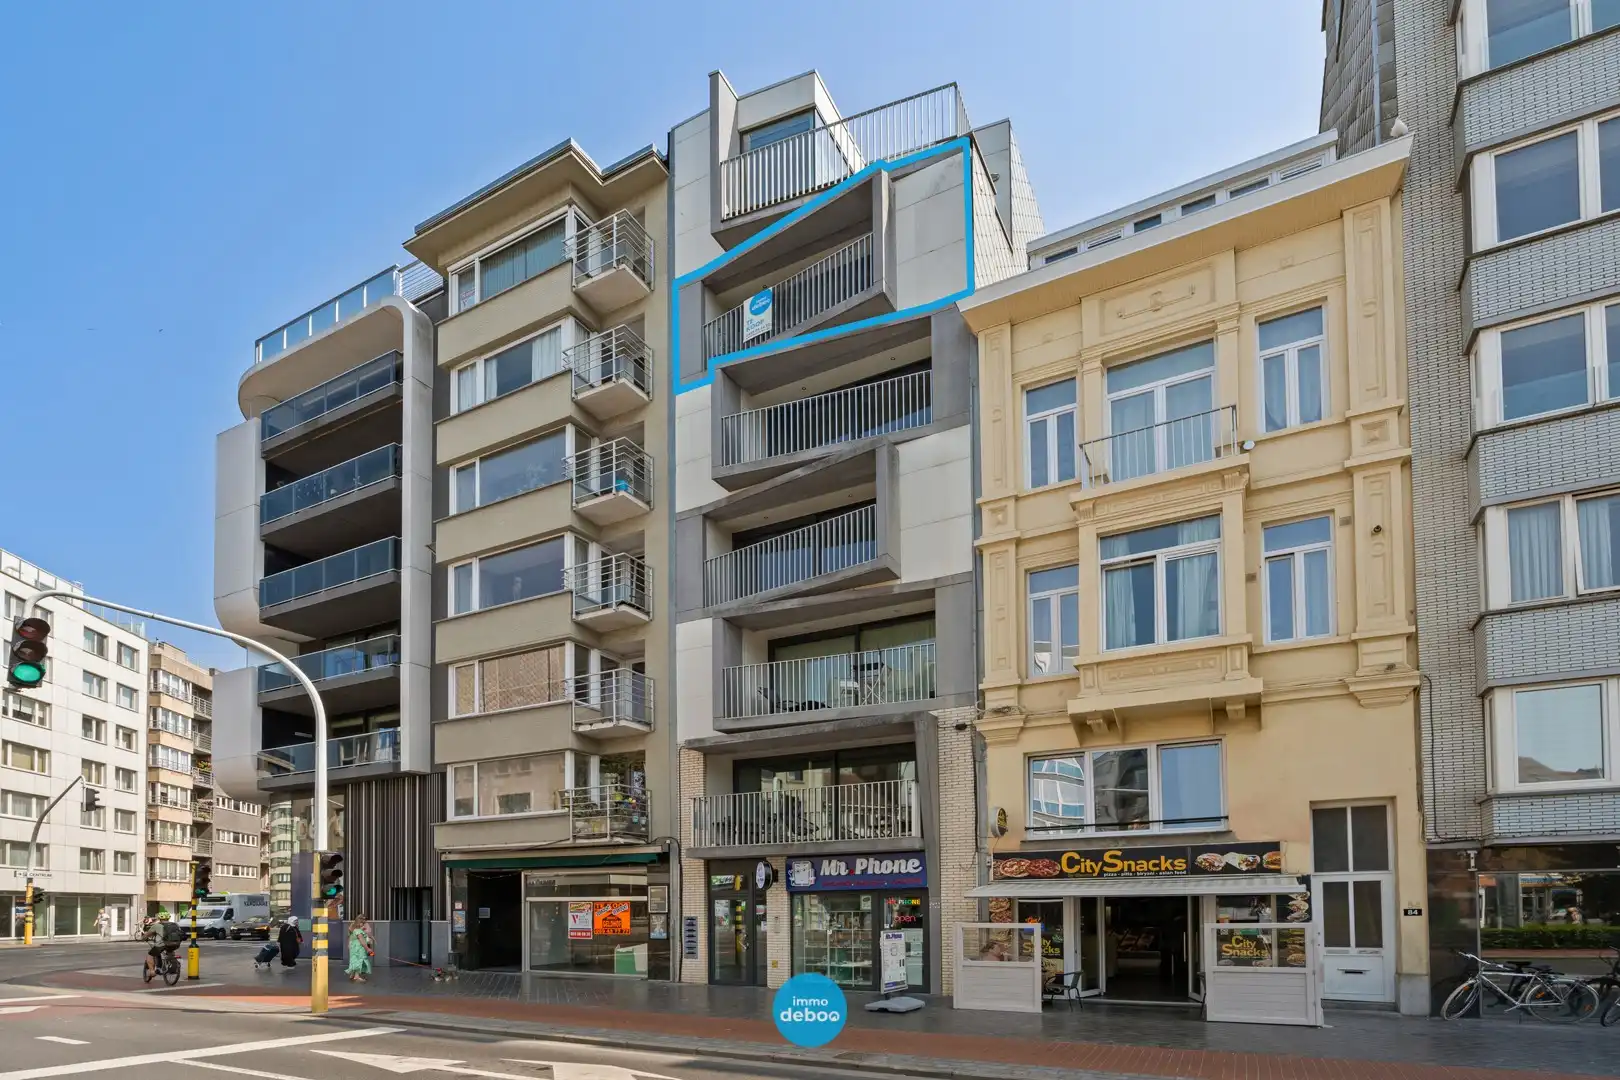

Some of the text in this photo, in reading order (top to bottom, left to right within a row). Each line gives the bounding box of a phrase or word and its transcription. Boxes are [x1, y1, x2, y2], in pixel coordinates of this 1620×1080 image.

[855, 857, 923, 875] Phone
[1061, 850, 1187, 876] City Snacks
[894, 914, 916, 923] open
[1221, 943, 1269, 957] Snacks
[1231, 935, 1257, 950] City
